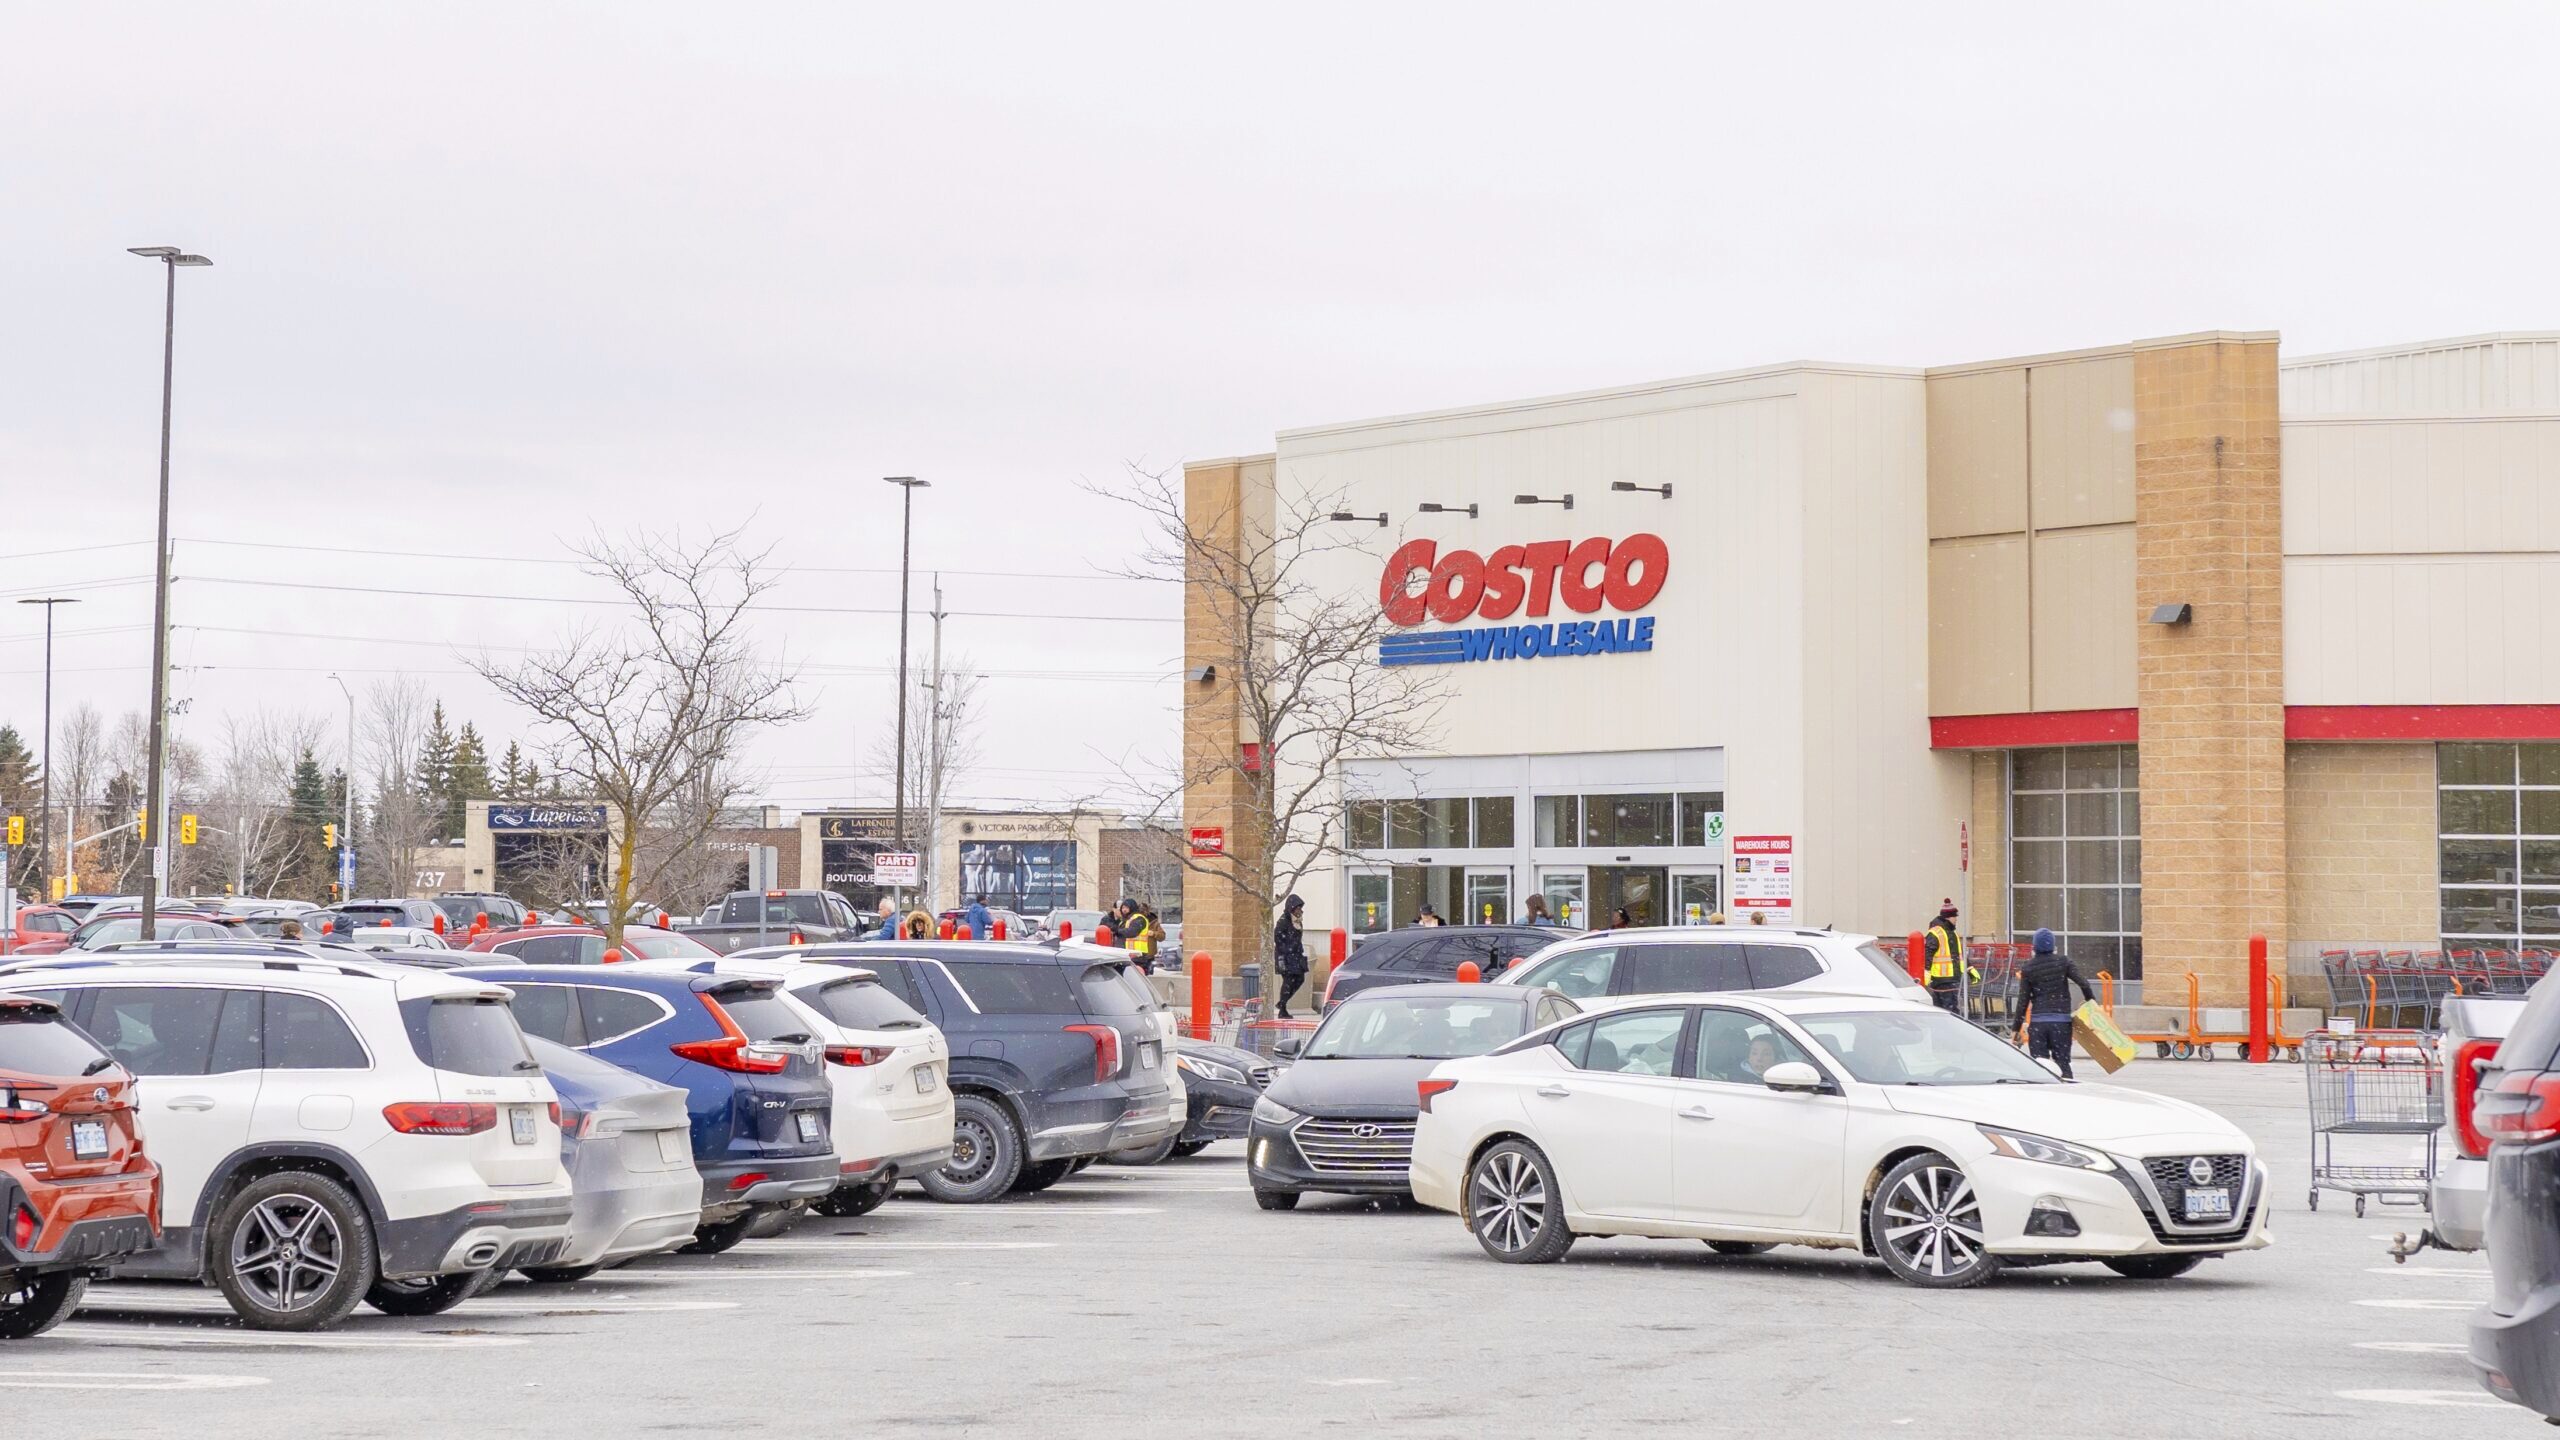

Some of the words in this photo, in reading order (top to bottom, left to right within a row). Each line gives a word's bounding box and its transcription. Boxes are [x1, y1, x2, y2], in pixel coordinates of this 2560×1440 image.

[1380, 533, 1669, 626] COSTCO
[1459, 616, 1656, 662] WHOLESALE
[979, 823, 1016, 832] VICTORIA
[1735, 840, 1770, 850] WAREHOUSE
[1770, 840, 1790, 850] HOURS
[877, 856, 915, 866] CARTS
[415, 871, 446, 888] 737
[826, 873, 875, 883] BOUTIQUE
[763, 1101, 786, 1109] CR-V
